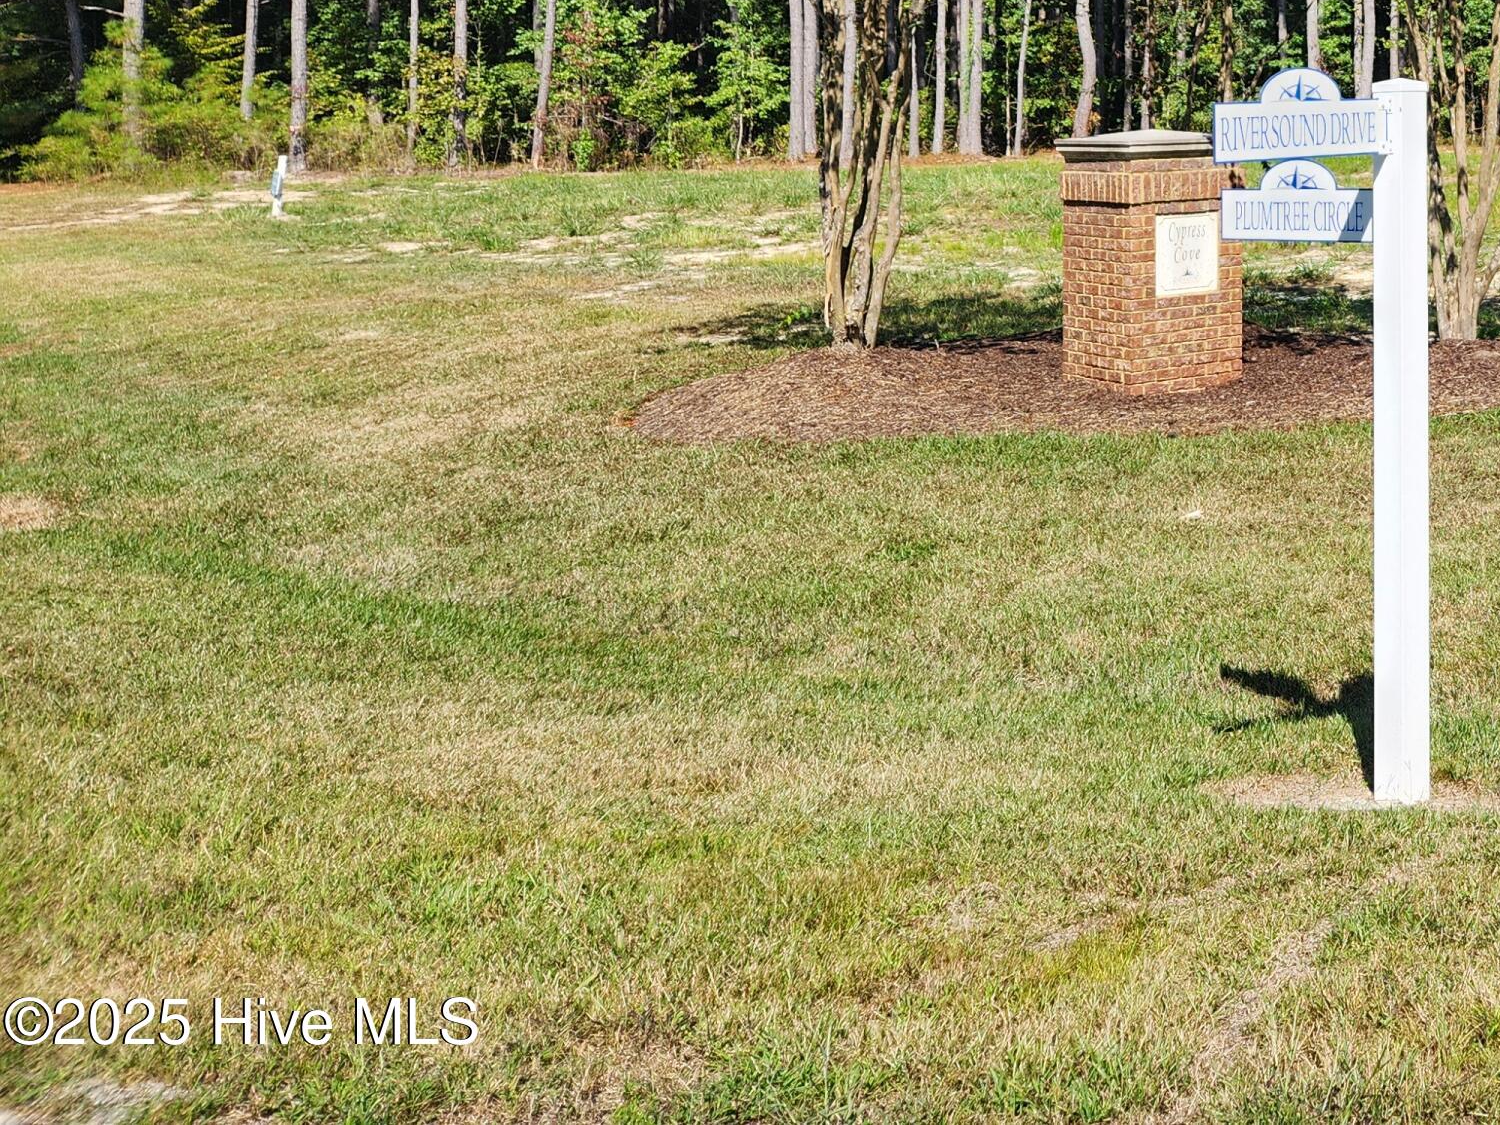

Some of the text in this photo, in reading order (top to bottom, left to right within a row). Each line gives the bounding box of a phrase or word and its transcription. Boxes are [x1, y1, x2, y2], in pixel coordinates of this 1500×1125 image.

[1221, 111, 1376, 152] RIVERSOUND DRIVE
[1235, 201, 1364, 233] PLUMTREE CIRCLE
[1168, 222, 1206, 246] Cypress
[1174, 246, 1201, 263] Cove
